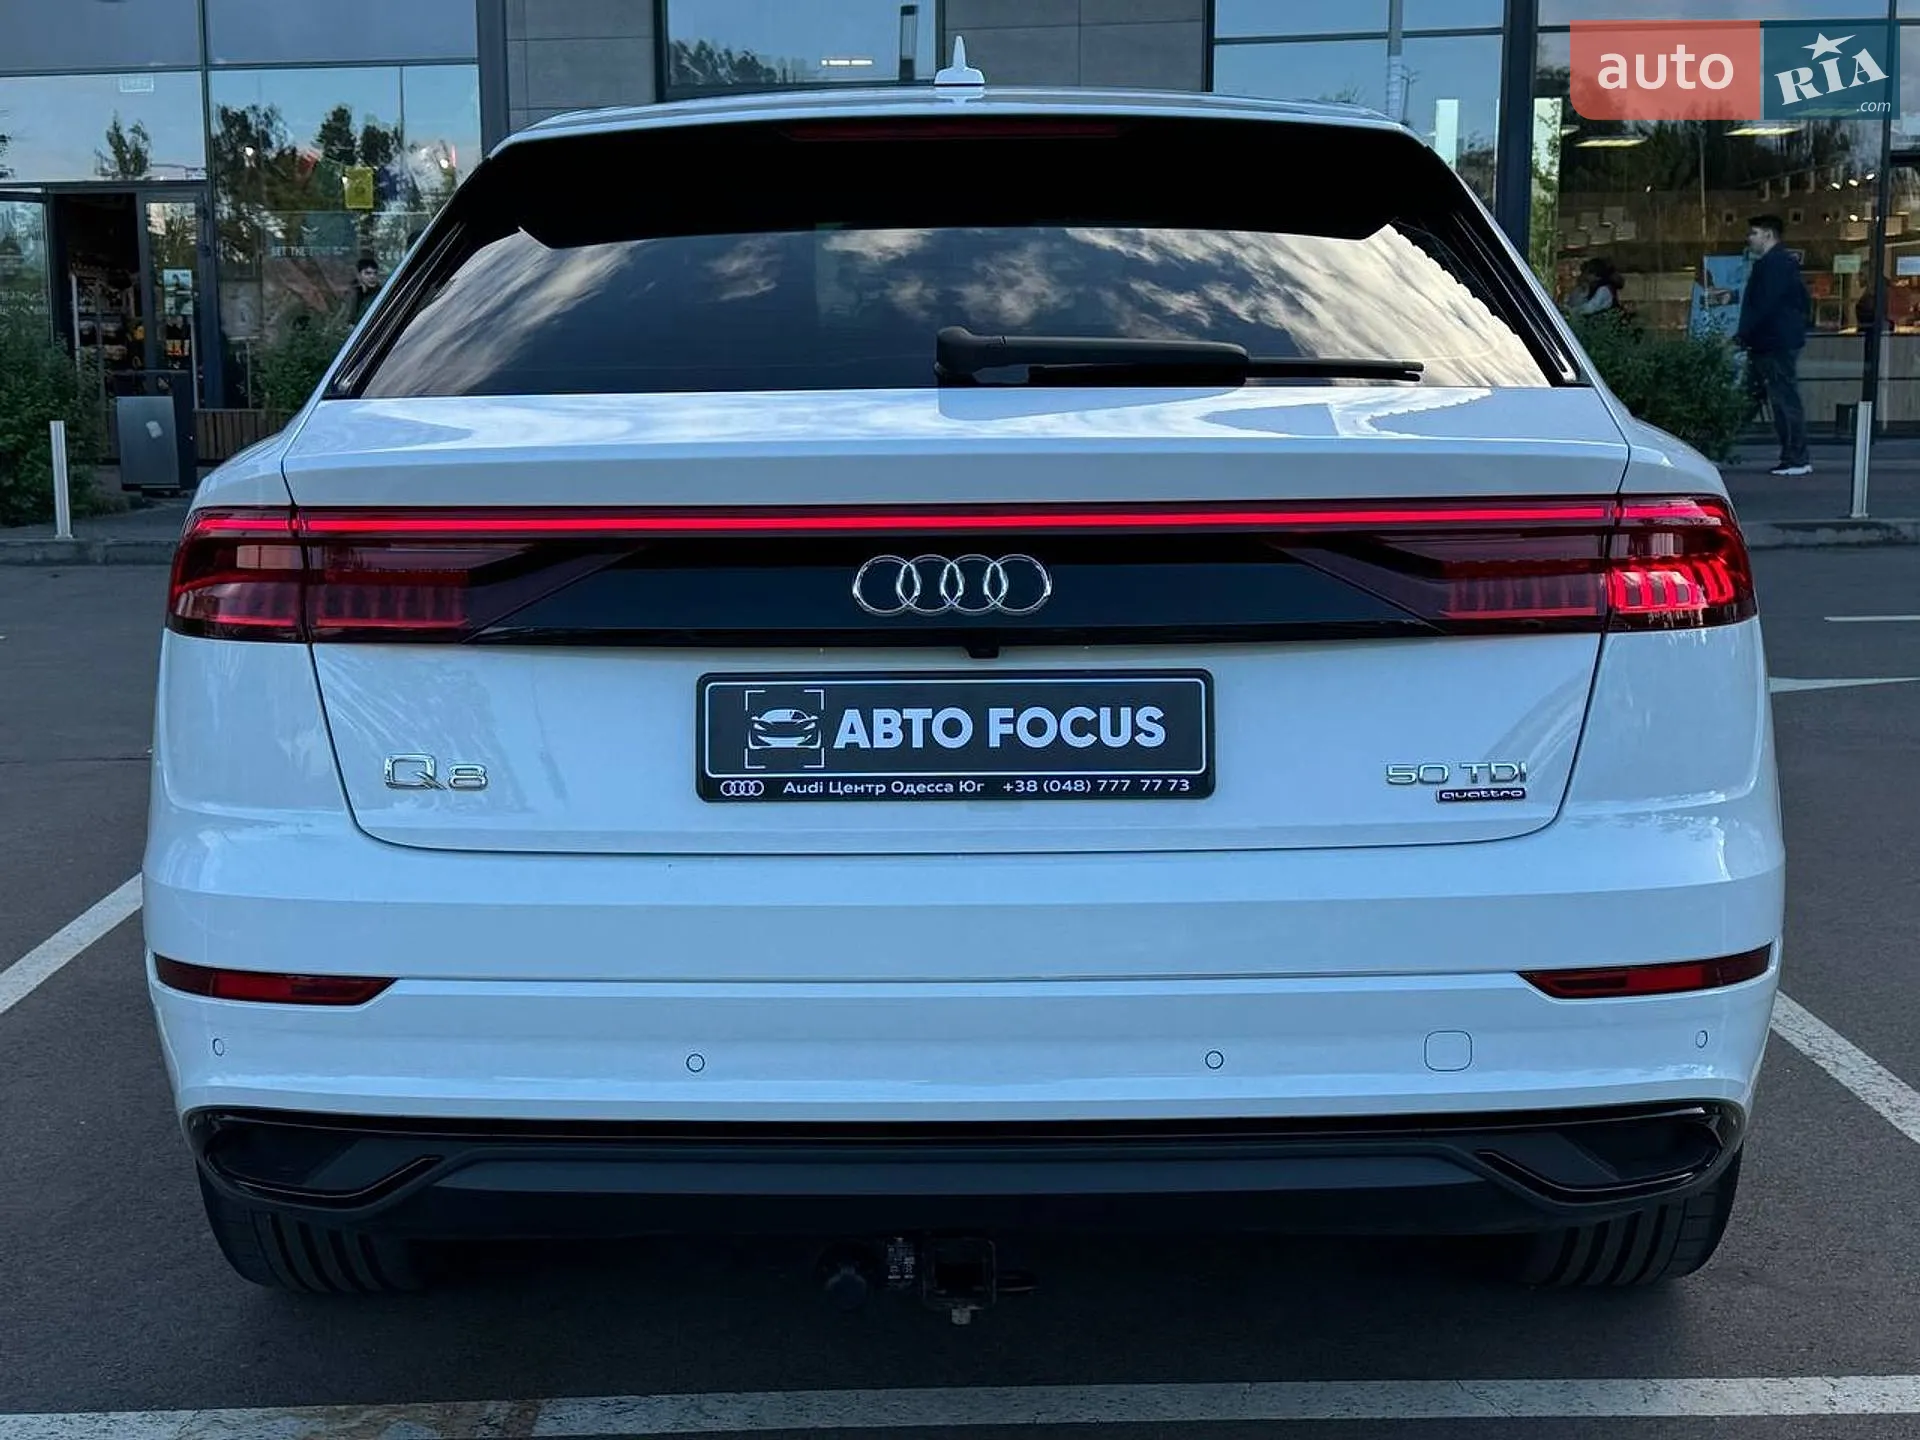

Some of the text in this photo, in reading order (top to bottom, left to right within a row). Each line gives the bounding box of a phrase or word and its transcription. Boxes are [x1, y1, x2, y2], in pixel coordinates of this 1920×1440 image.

[988, 706, 1166, 748] FOCUS
[384, 752, 488, 790] Q8
[1386, 761, 1527, 785] 50 TDI
[783, 779, 1190, 796] Audi Центр Одесса Юг +38 (048) 777 77 73
[1441, 789, 1523, 800] quattro
